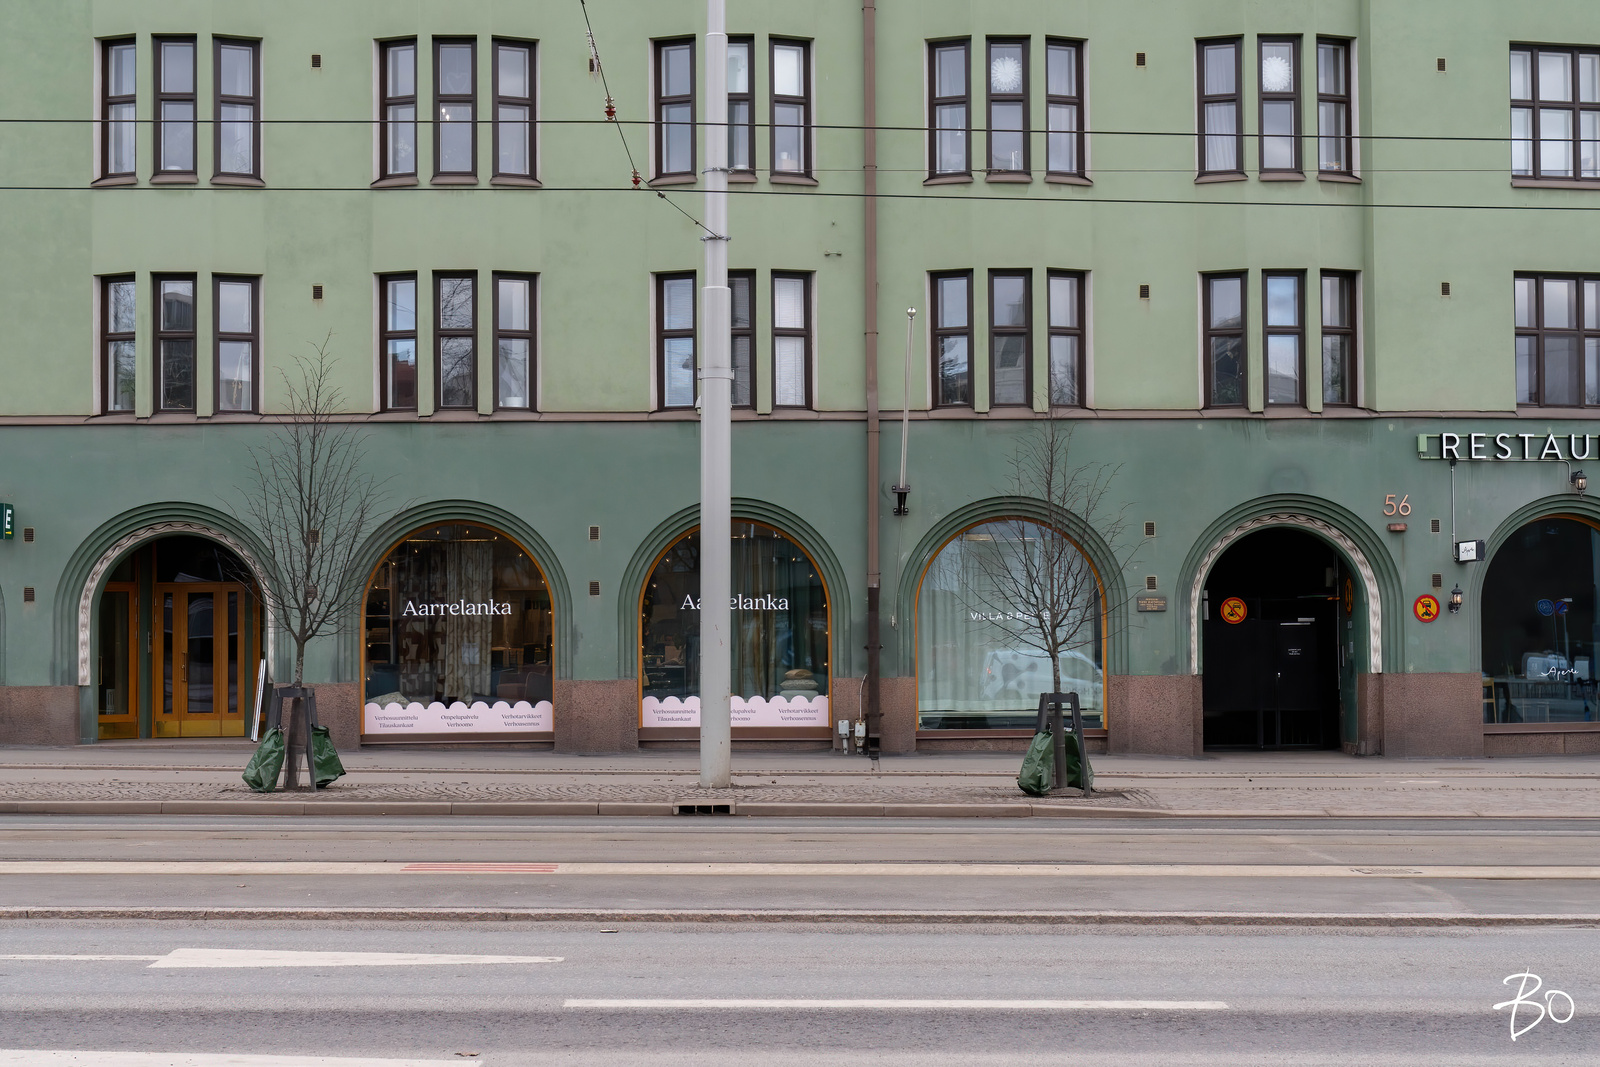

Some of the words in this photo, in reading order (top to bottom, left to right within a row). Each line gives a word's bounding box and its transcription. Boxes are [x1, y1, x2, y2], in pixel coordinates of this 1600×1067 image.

[1442, 432, 1590, 460] RESTAU
[1383, 494, 1411, 516] 56
[402, 598, 512, 616] Aarrelanka
[680, 593, 789, 610] Aelanka
